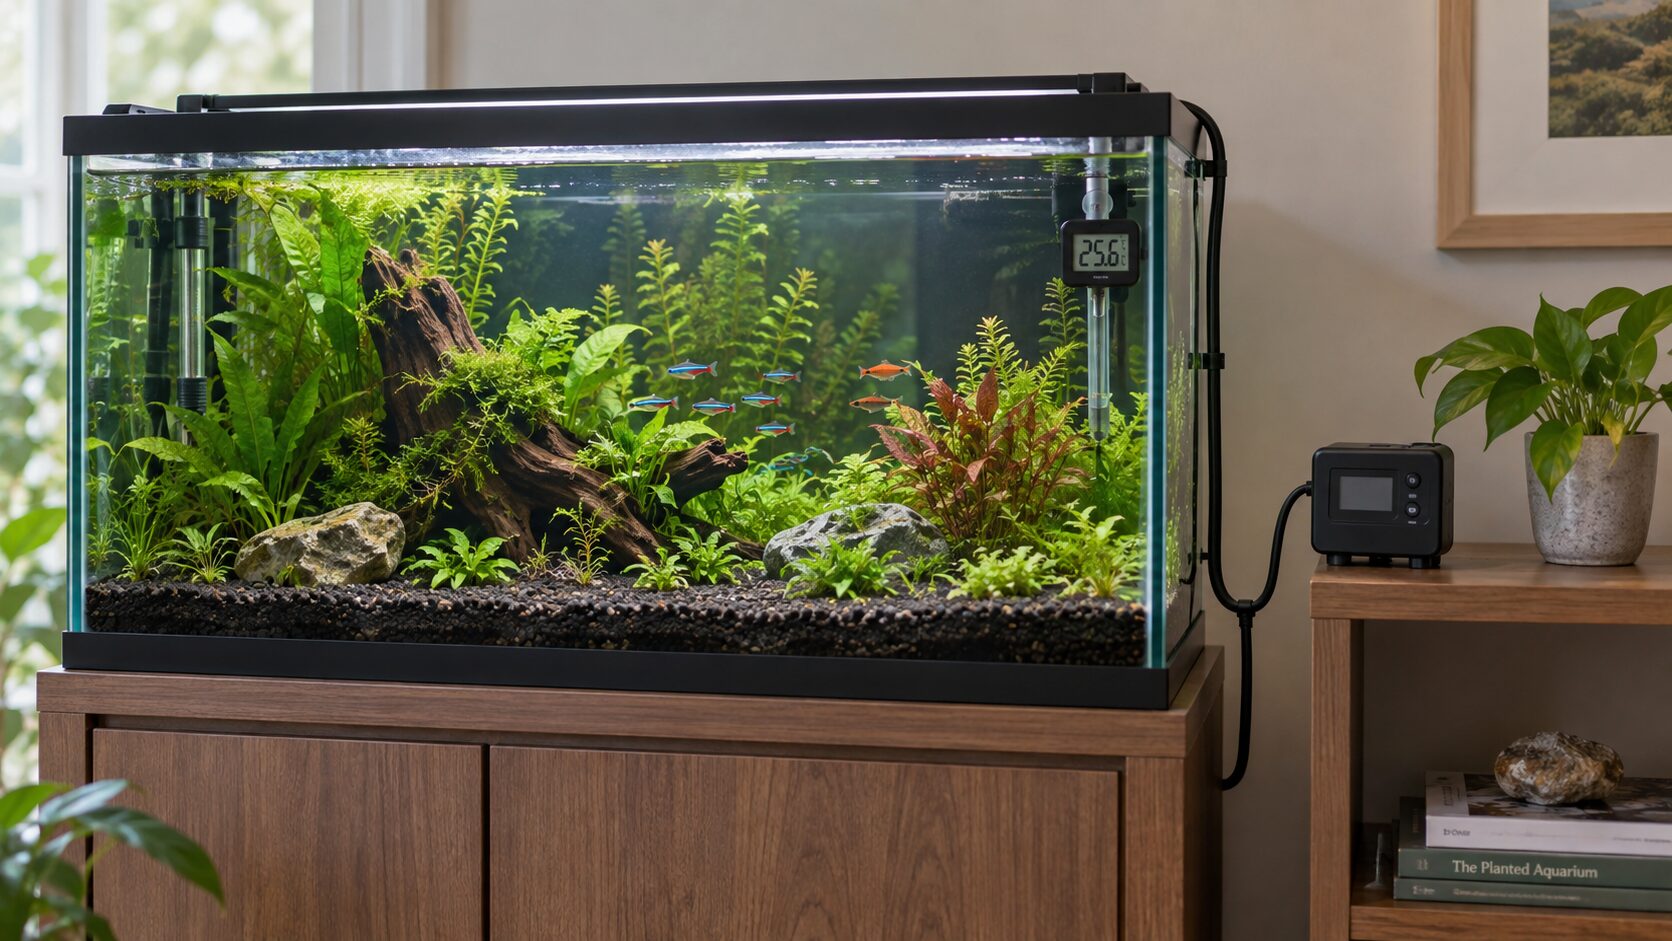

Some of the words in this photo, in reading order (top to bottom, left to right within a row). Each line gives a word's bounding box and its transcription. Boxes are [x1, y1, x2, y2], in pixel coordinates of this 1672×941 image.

[1079, 239, 1119, 267] 25.6
[1452, 859, 1477, 873] The
[1481, 860, 1530, 876] Planted
[1533, 862, 1598, 879] Aquarium
